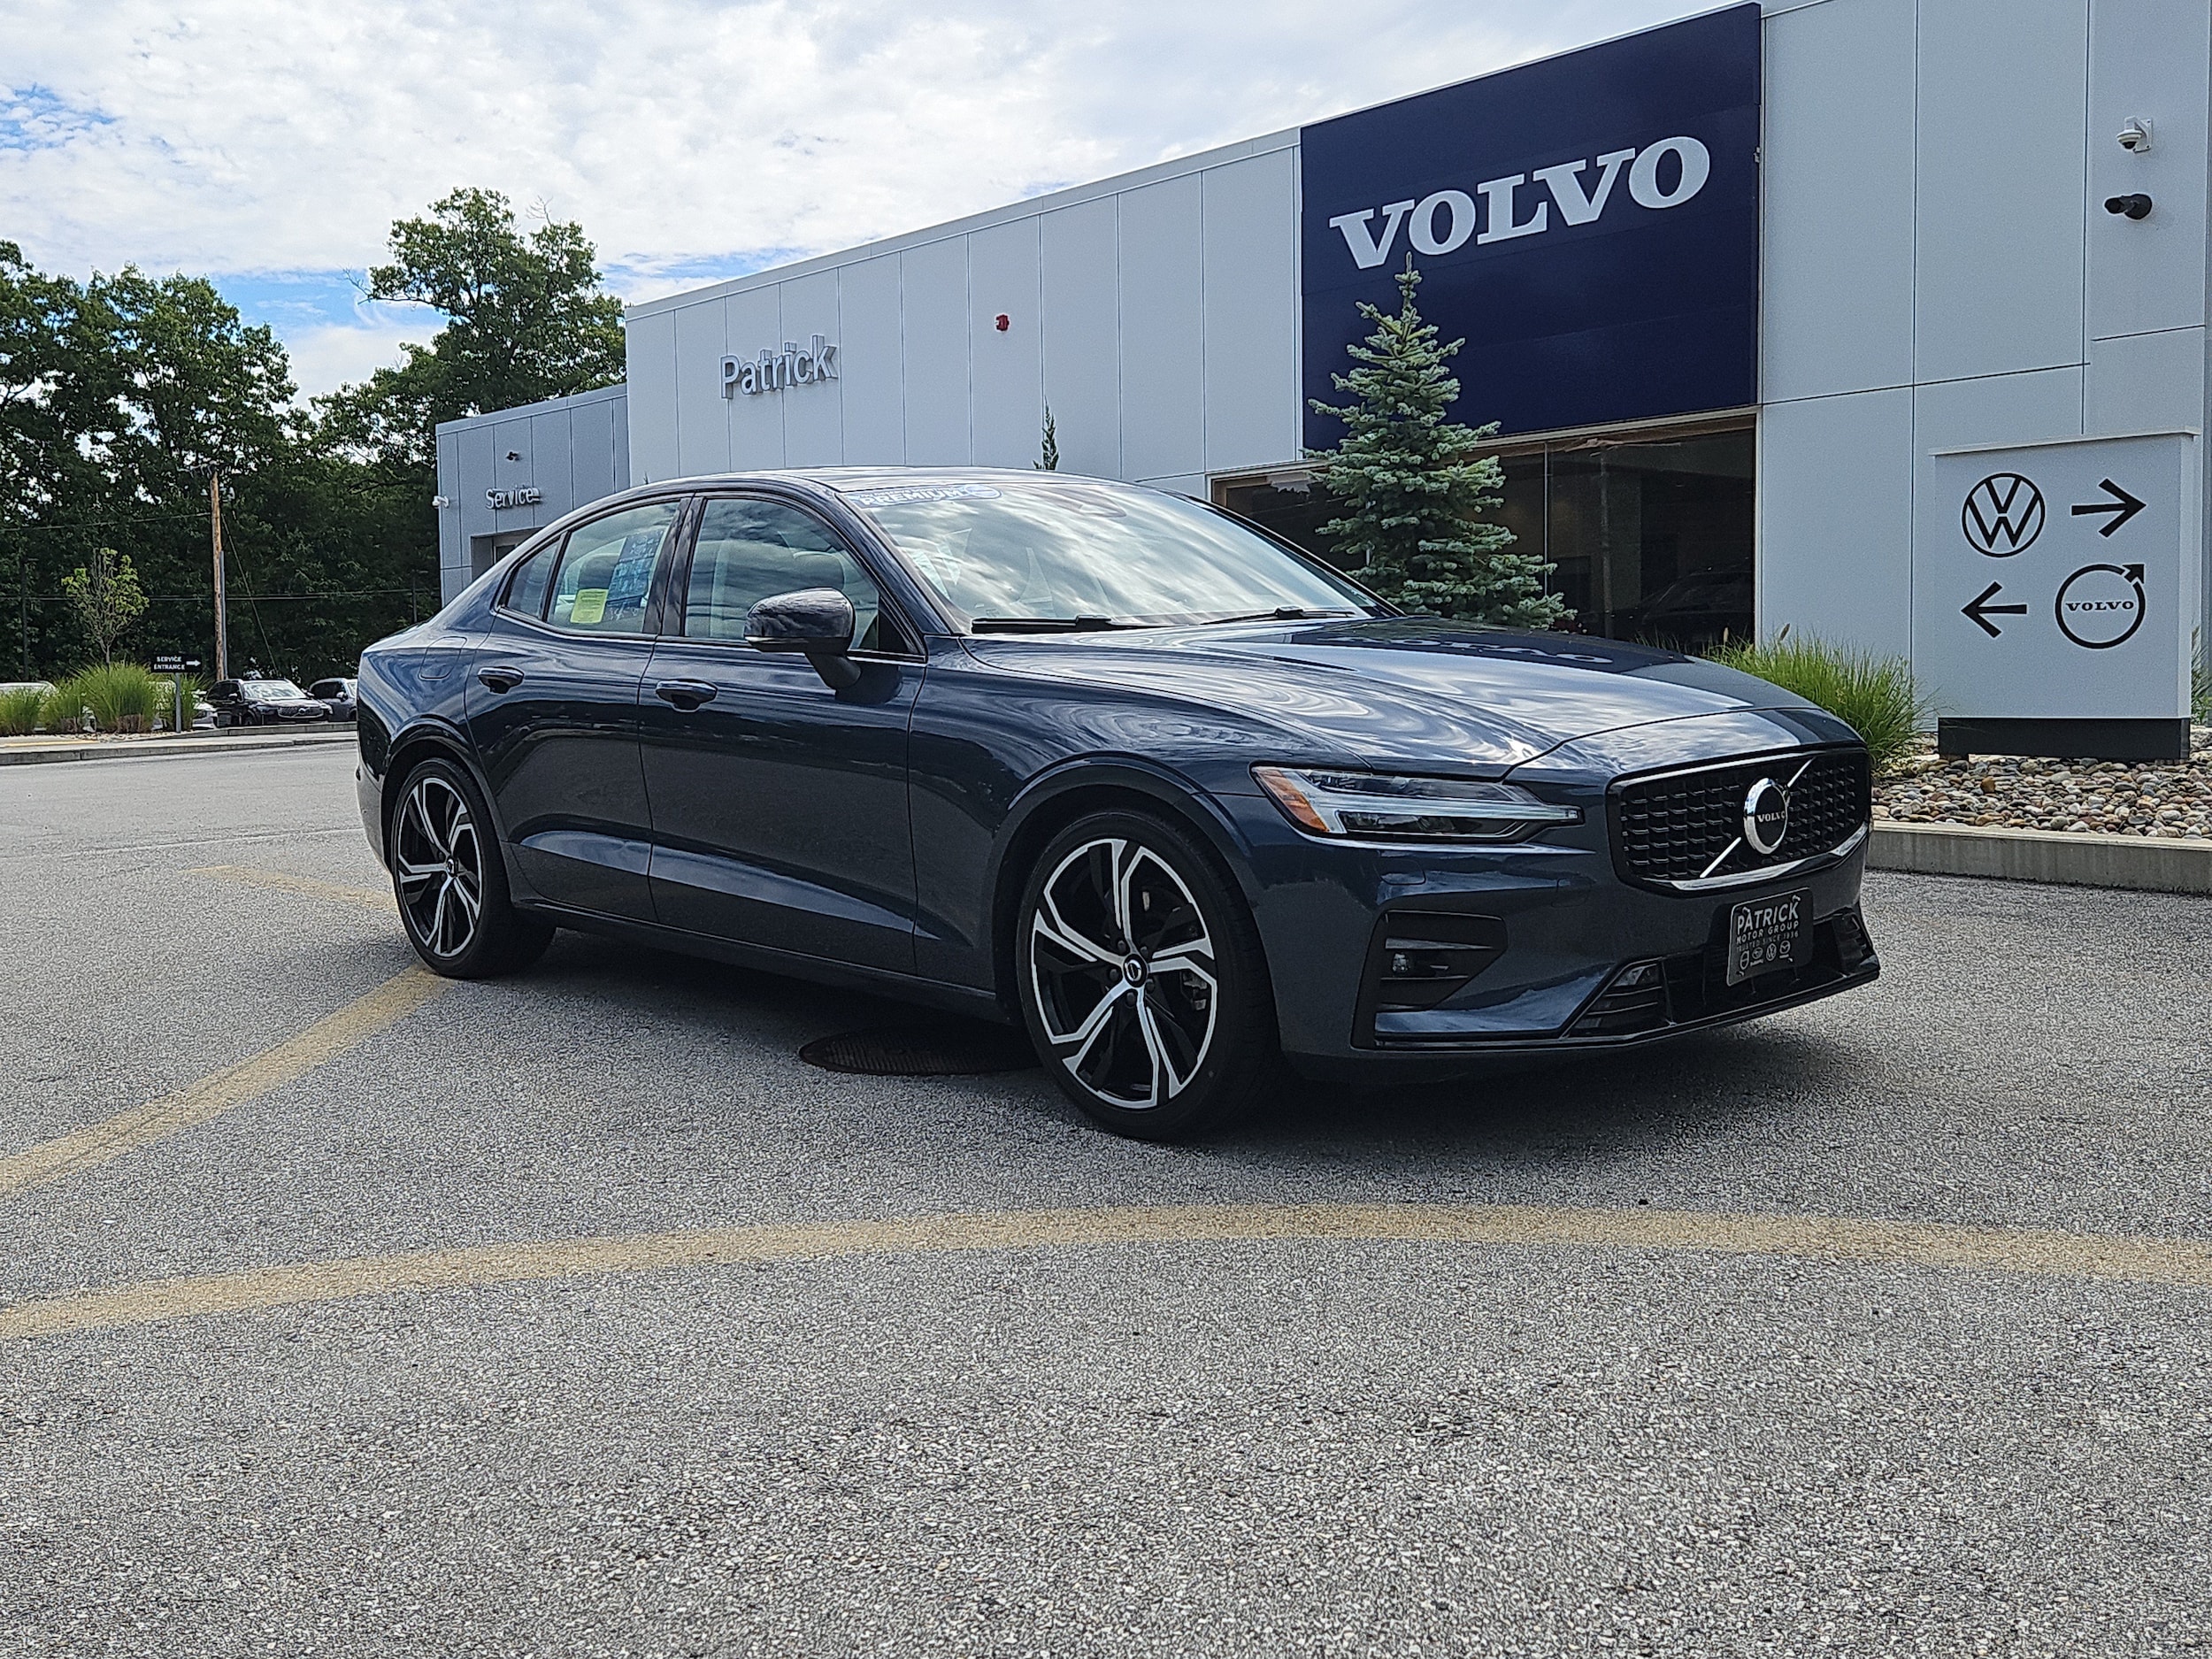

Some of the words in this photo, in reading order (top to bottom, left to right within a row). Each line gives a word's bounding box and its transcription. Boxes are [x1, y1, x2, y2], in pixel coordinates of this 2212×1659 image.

[1329, 136, 1710, 269] VOLVO
[719, 334, 839, 399] Patrick
[485, 488, 541, 510] Service
[860, 488, 964, 505] PREMIUM
[2065, 600, 2135, 611] VOLVO
[1757, 810, 1786, 823] VOLVO
[1737, 902, 1799, 935] PATRICK
[1737, 929, 1764, 945] MOTOR
[1768, 920, 1799, 934] GROUP
